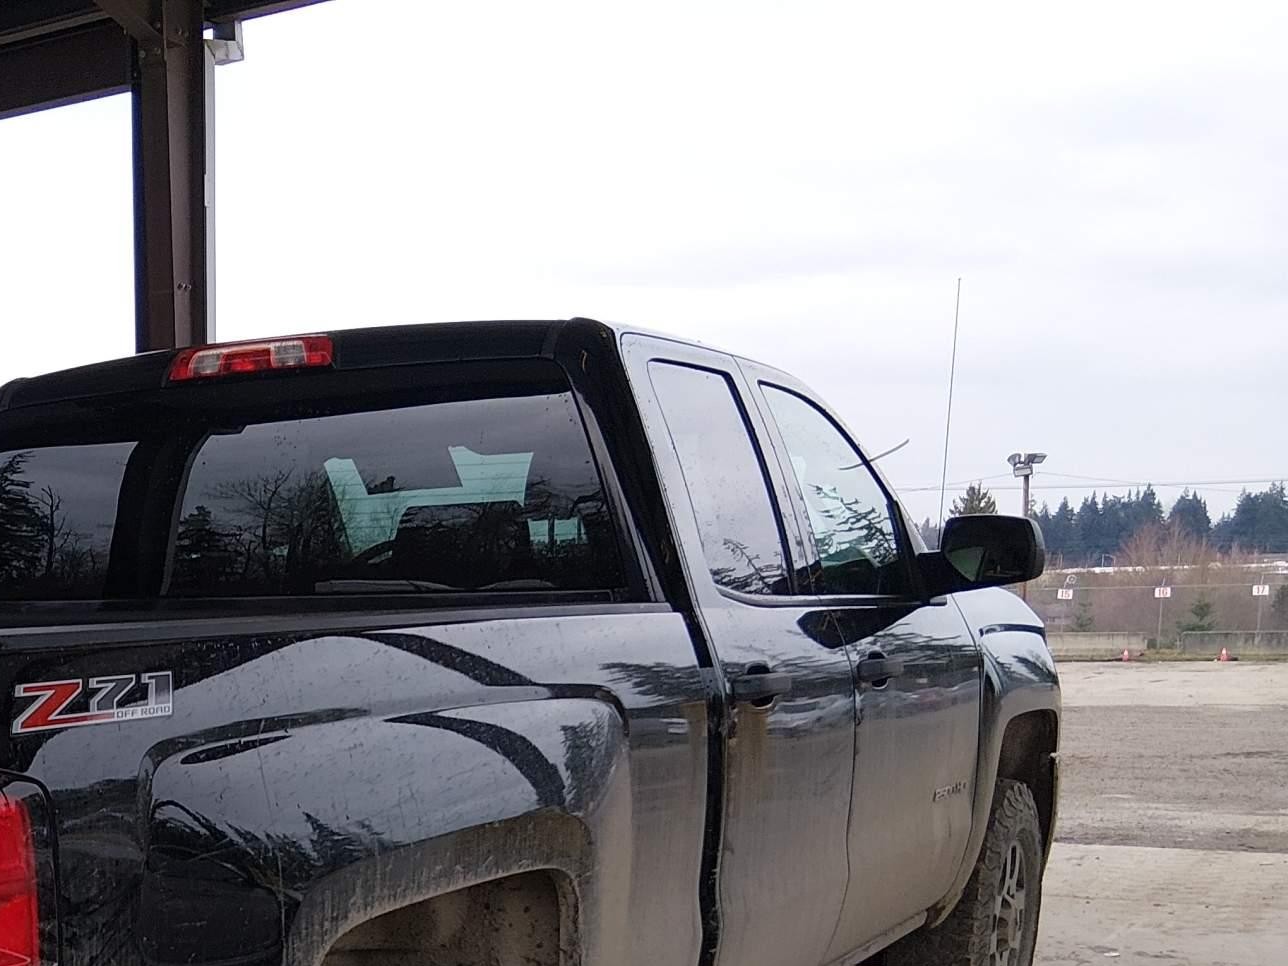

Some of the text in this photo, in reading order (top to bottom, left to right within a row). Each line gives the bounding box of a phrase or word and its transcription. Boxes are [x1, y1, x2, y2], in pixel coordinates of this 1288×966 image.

[12, 671, 172, 733] Z71
[116, 705, 171, 720] OFF ROAD
